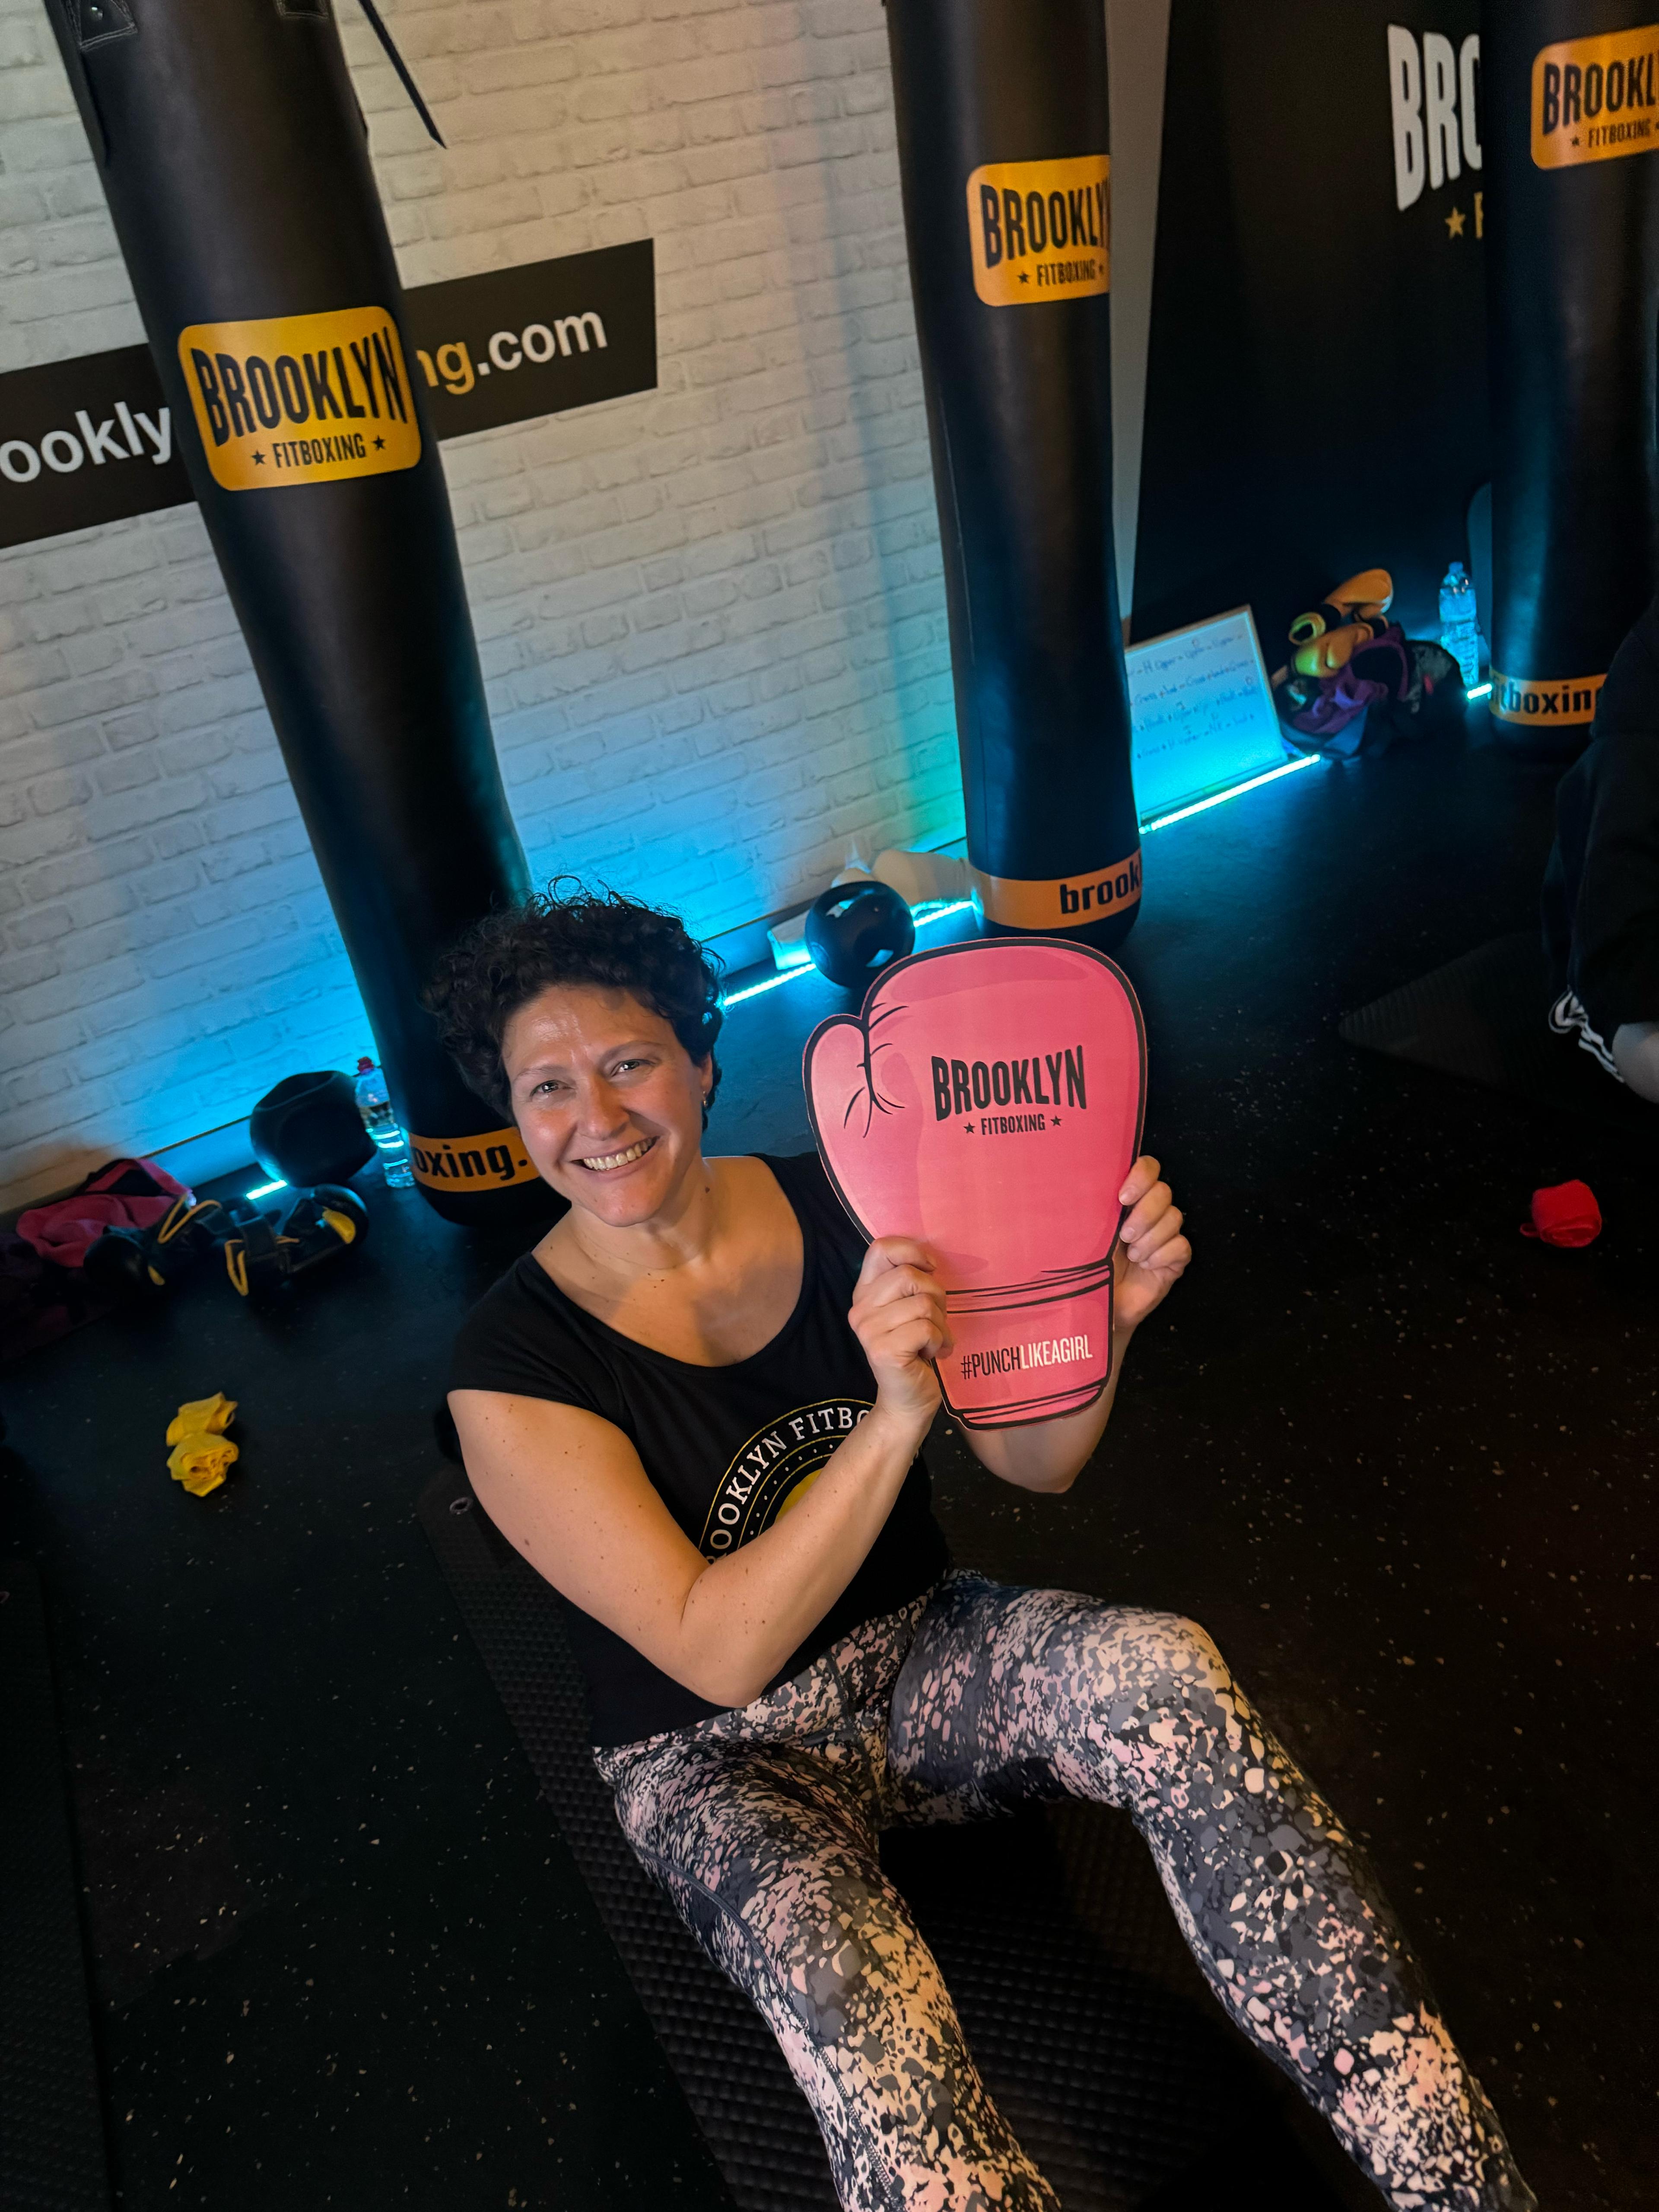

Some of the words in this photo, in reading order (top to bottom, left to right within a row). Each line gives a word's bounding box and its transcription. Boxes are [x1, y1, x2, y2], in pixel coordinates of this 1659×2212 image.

[1543, 49, 1659, 136] BROOKL
[1036, 259, 1096, 287] FITBOXING
[191, 327, 407, 447] BROOKLYN
[272, 433, 366, 467] FITBOXING
[931, 1045, 1087, 1121] BROOKLYN
[981, 1114, 1046, 1135] FITBOXING
[960, 1334, 1093, 1379] #PUNCHLIKEAGIRL
[706, 1430, 787, 1564] OOKLYN
